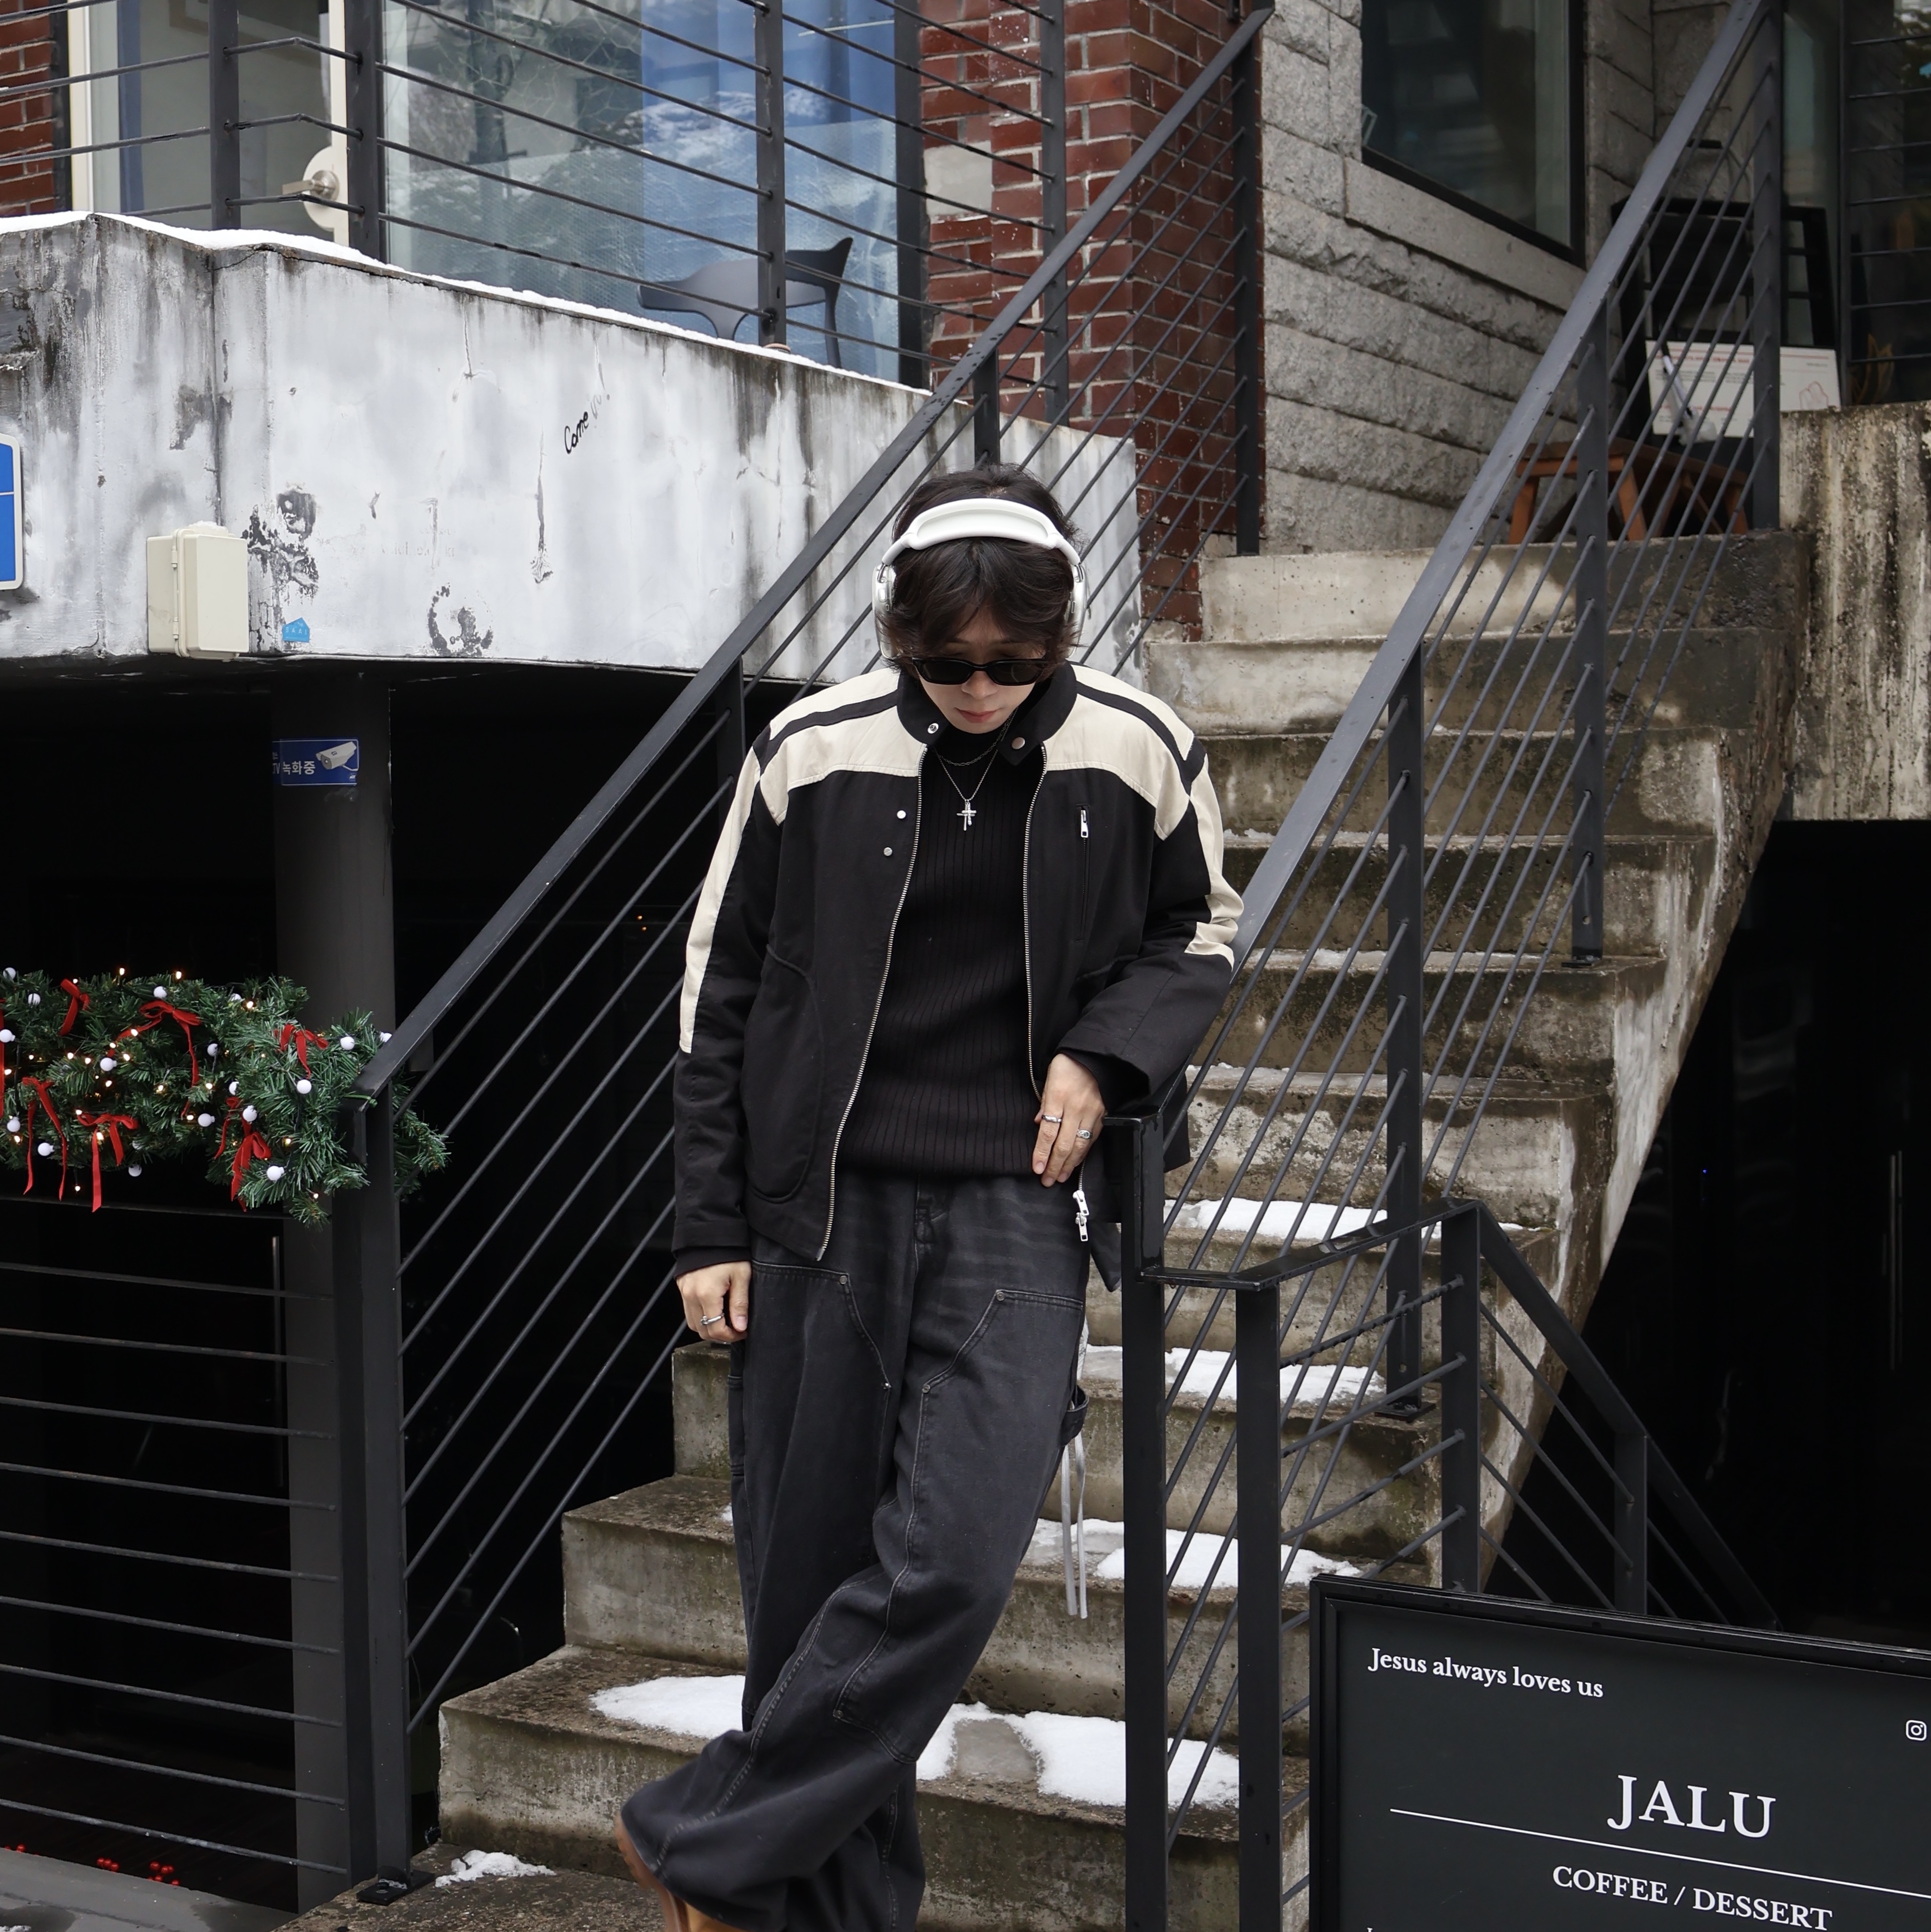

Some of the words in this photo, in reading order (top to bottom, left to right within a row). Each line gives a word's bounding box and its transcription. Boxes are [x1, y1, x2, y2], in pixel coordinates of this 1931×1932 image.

[564, 411, 589, 455] Come
[272, 762, 280, 774] TV
[282, 760, 315, 775] 녹화중
[1368, 1647, 1427, 1673] Jesus
[1433, 1657, 1507, 1687] always
[1512, 1666, 1571, 1693] loves
[1576, 1681, 1604, 1698] us
[1607, 1775, 1776, 1838] JALU
[1553, 1866, 1668, 1904] COFFEE
[1692, 1888, 1833, 1931] DESSERT
